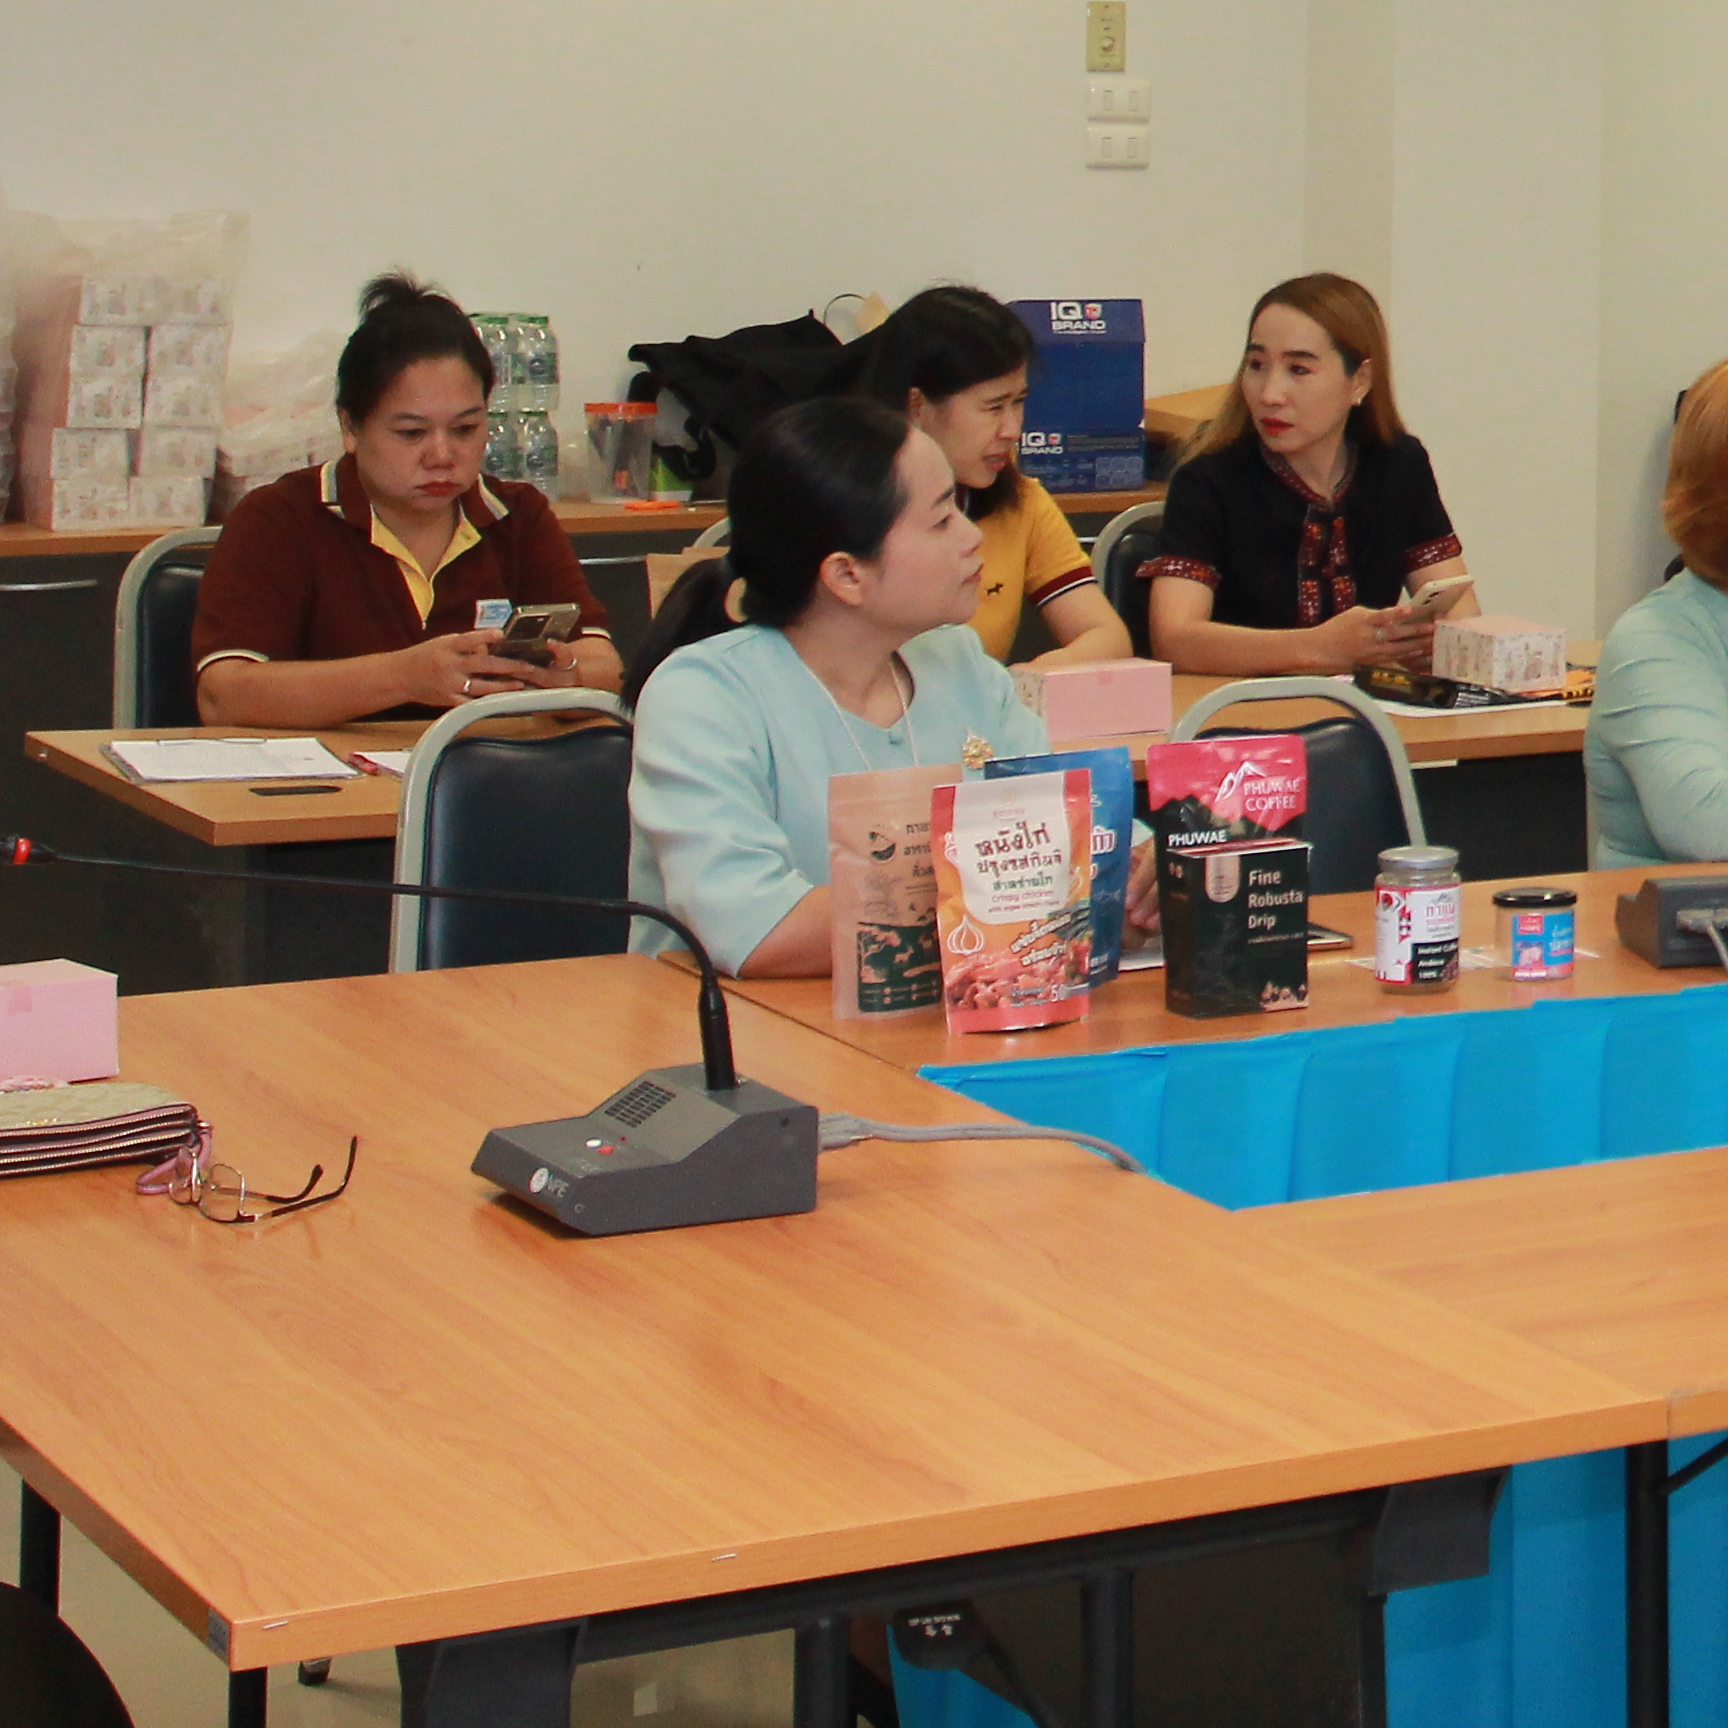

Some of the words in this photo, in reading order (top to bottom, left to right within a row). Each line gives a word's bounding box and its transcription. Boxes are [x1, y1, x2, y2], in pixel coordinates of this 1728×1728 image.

[1050, 301, 1083, 321] IQ
[1051, 320, 1106, 331] BRAND
[1021, 432, 1047, 447] IQ
[1021, 447, 1064, 455] BRAND
[1244, 777, 1300, 797] PHUWAE
[1246, 795, 1297, 812] COFFEE
[975, 821, 1051, 858] หนังไก่
[1168, 828, 1228, 847] PHUWAE
[1249, 869, 1281, 886] Fine
[1248, 890, 1304, 908] Robusta
[1248, 915, 1277, 930] Drip
